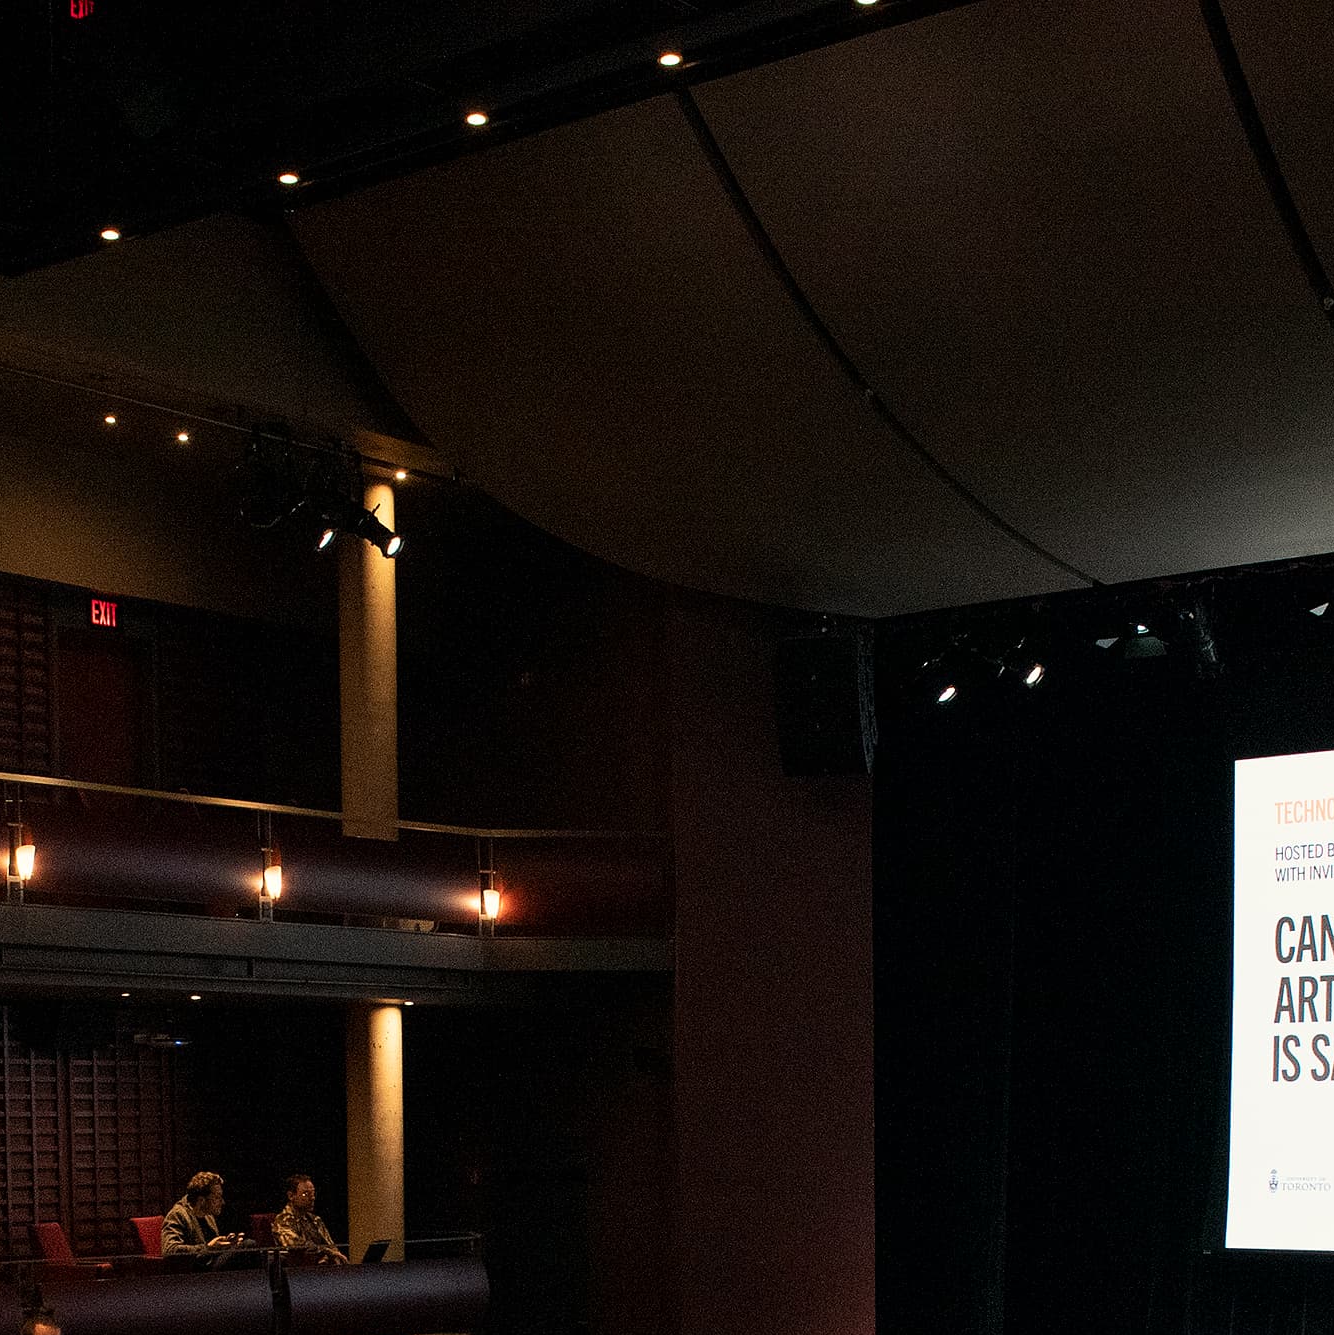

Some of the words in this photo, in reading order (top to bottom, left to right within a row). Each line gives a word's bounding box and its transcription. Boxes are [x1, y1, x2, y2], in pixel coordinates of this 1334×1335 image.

[70, 0, 95, 19] EXIT
[92, 599, 117, 628] EXIT
[1275, 844, 1323, 861] HOSTED
[1275, 866, 1305, 882] WITH
[1272, 1034, 1300, 1082] IS
[1282, 1183, 1331, 1191] TORONTO
